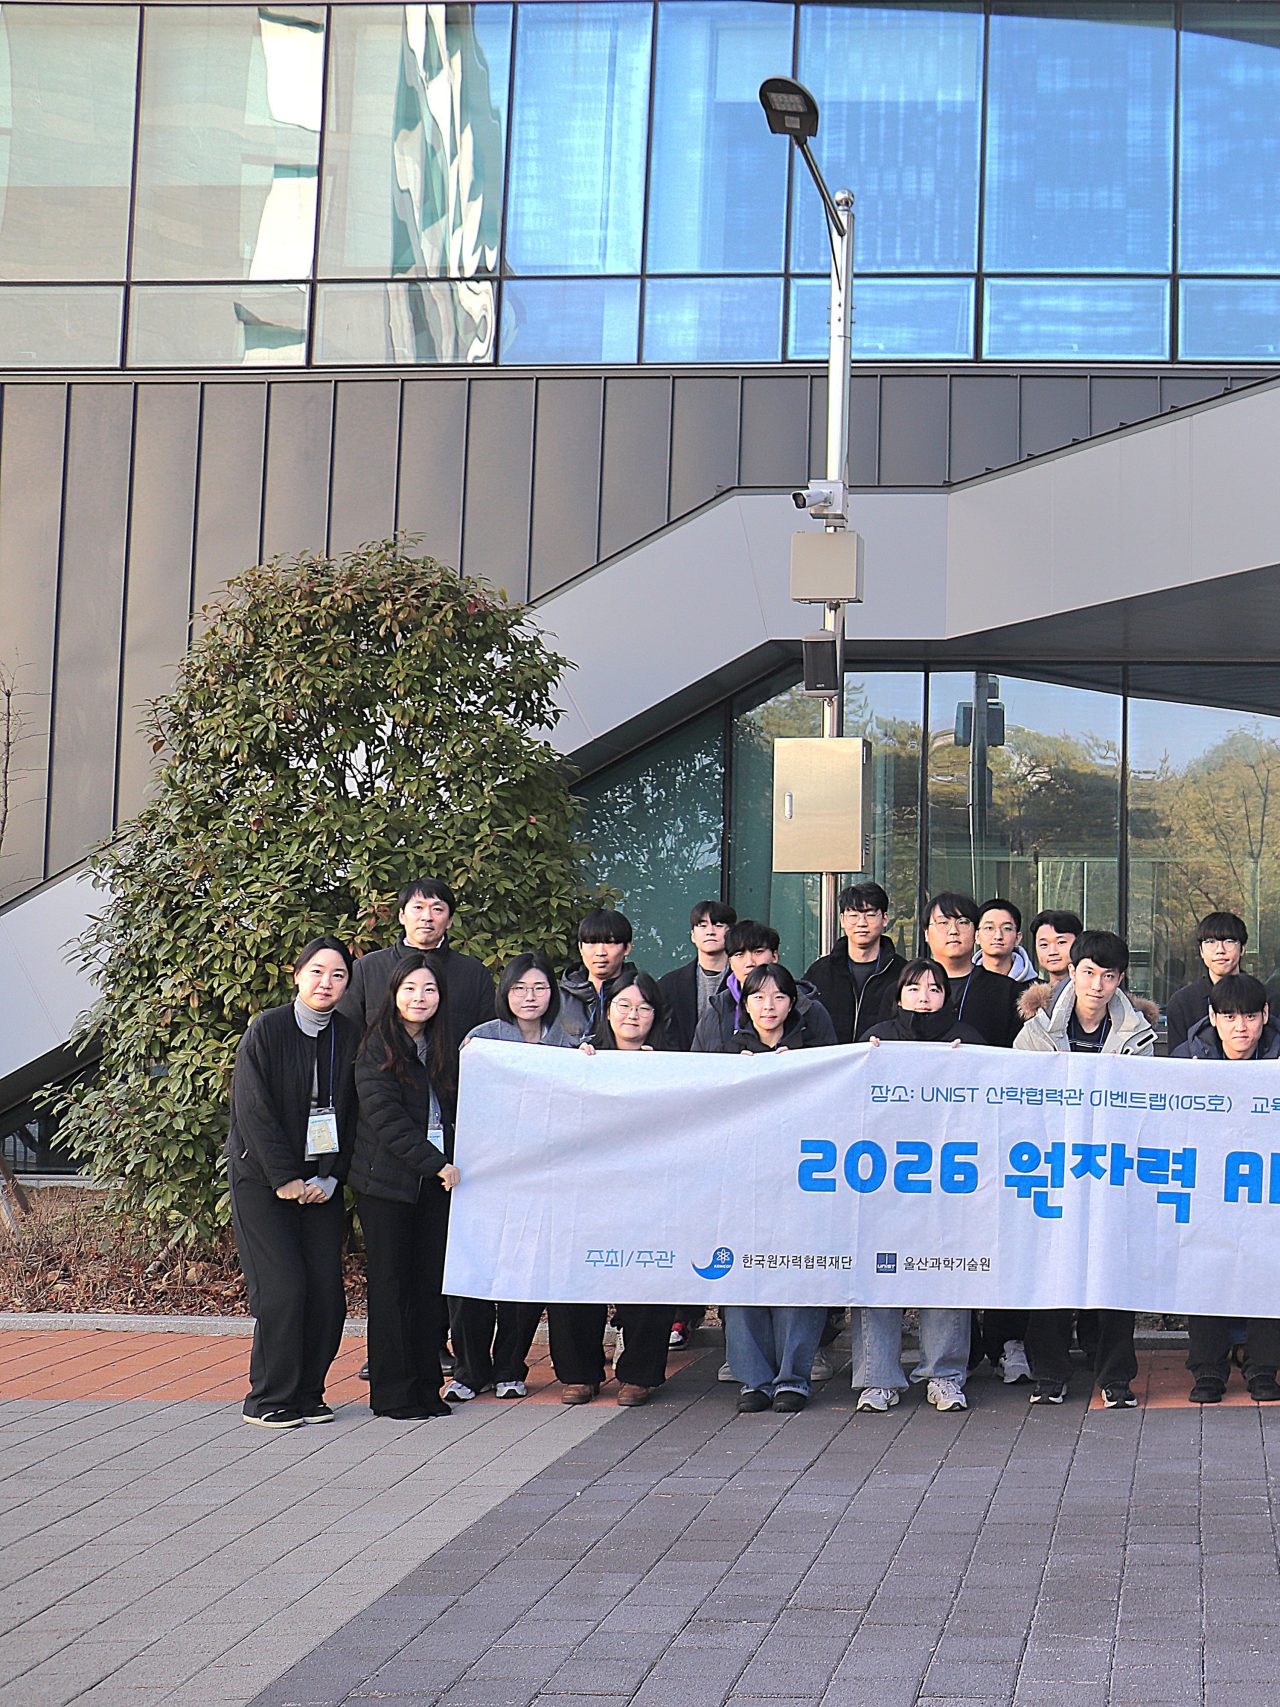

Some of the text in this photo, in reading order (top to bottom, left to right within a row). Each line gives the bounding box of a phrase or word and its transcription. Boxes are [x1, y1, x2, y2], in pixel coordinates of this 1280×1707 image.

[871, 1085, 914, 1102] 장소:
[922, 1087, 979, 1102] UNIST
[986, 1087, 1084, 1105] 산학협력관
[1090, 1090, 1232, 1113] 이벤트랩(105호)
[798, 1140, 978, 1193] 2026
[1005, 1142, 1196, 1223] 원자력
[585, 1249, 675, 1268] 주최/주관
[743, 1255, 852, 1269] 한국원자력협력재단
[904, 1257, 990, 1271] 울산과학기술원
